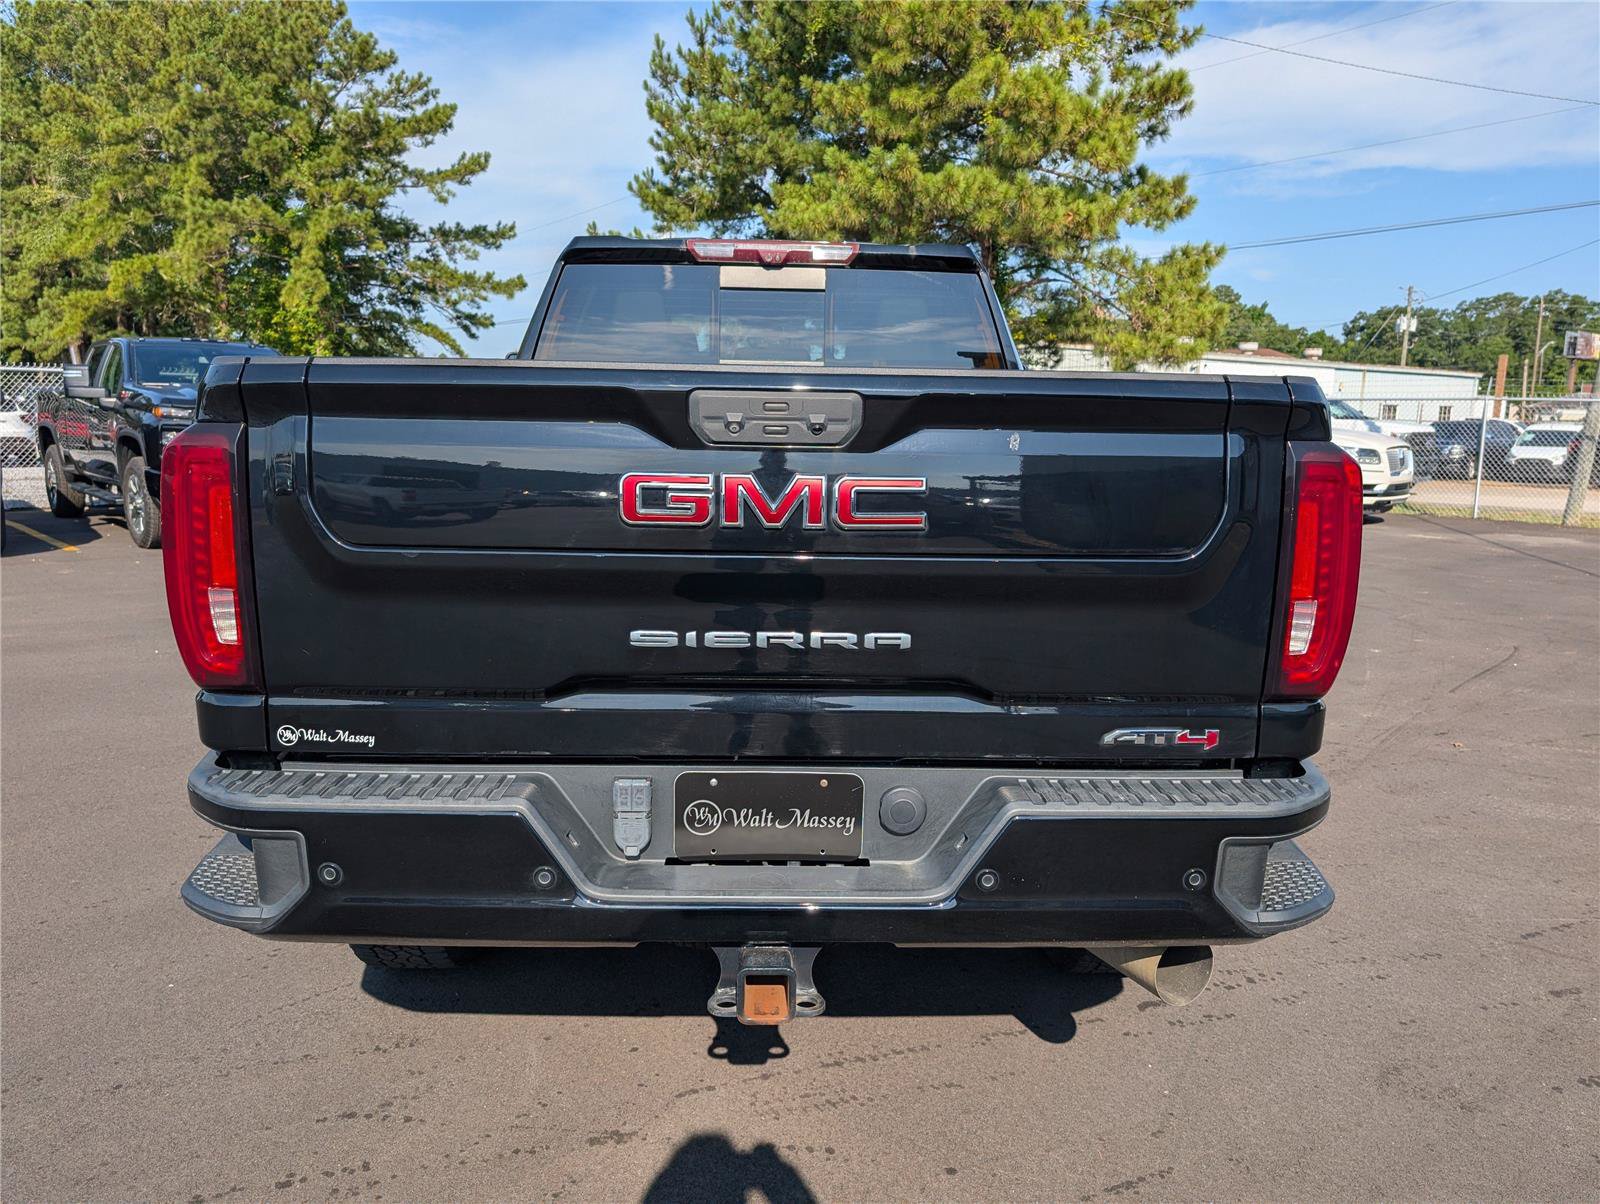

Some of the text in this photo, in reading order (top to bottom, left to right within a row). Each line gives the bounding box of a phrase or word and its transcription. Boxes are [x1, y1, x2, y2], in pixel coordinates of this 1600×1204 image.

[619, 472, 929, 531] GMC
[629, 630, 912, 650] SIERRA
[298, 728, 327, 742] Walt
[328, 729, 376, 748] Massey
[1101, 728, 1220, 751] AT4
[723, 808, 774, 828] Walt
[775, 808, 856, 836] Massey
